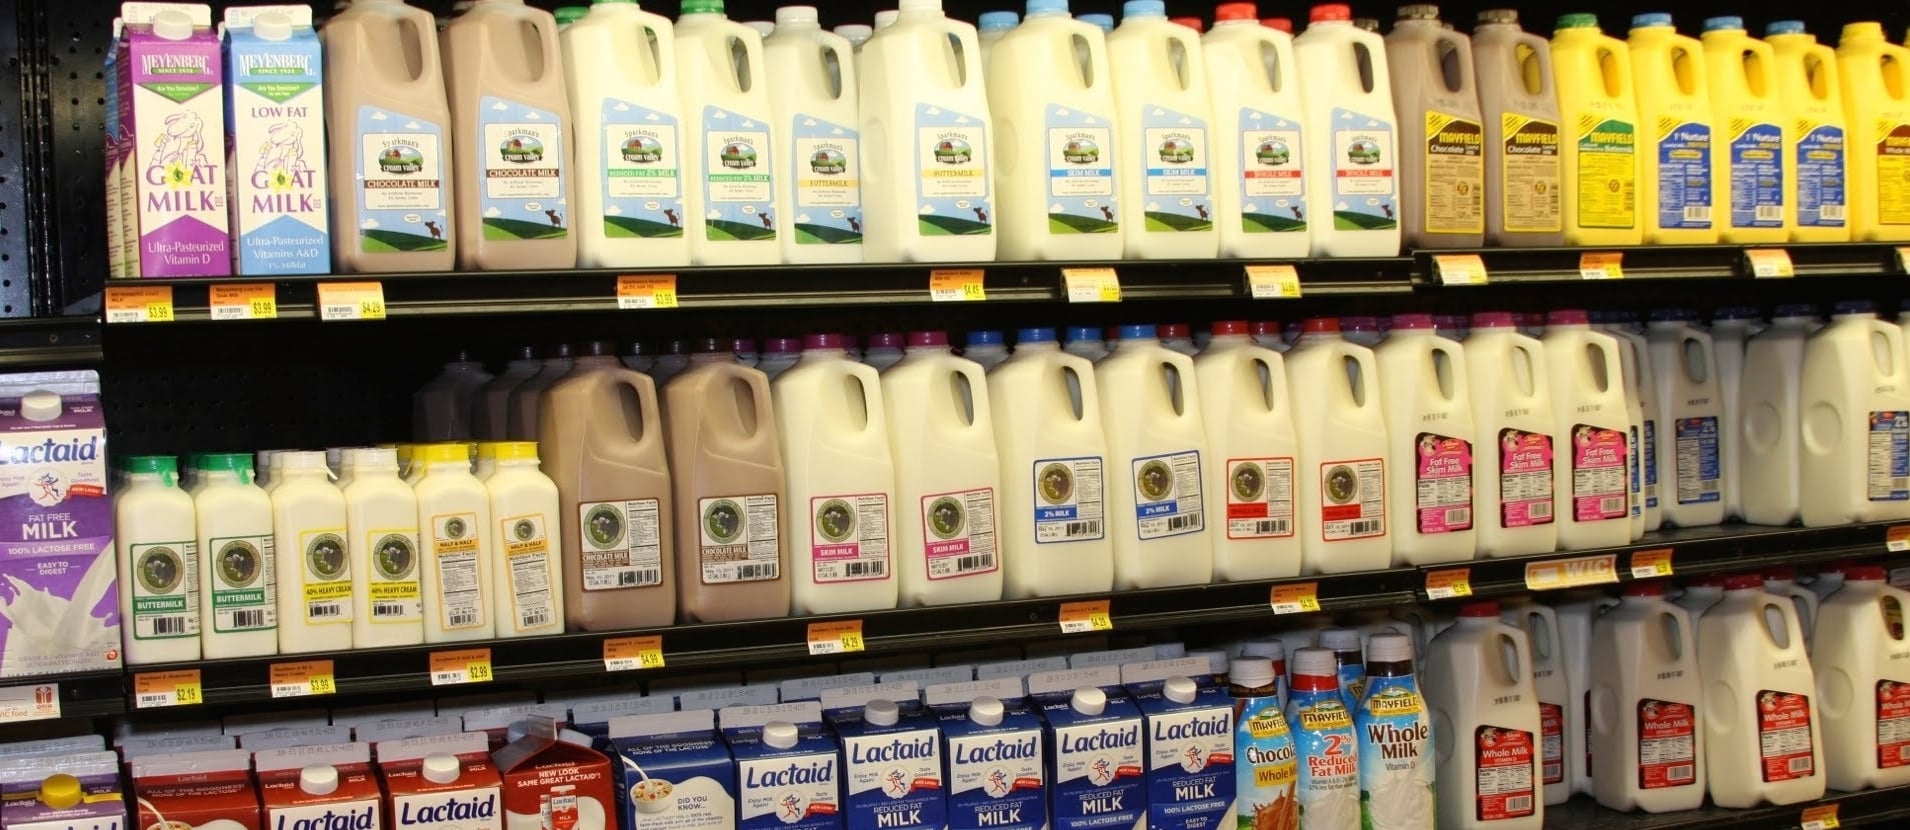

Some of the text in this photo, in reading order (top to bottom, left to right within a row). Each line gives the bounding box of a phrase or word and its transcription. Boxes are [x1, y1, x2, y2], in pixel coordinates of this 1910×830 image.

[142, 53, 213, 75] MEYENBERG
[240, 53, 315, 76] MEYENBERG
[251, 107, 310, 119] LOW FAT
[1439, 132, 1481, 144] MAYFIELD
[1516, 132, 1558, 144] MAYFIELD
[1431, 145, 1465, 153] Chocolate
[1508, 145, 1541, 153] Chocolate
[537, 169, 557, 177] MILK
[934, 169, 974, 178] BUTTERMILK
[1162, 168, 1195, 176] SKIM MILK
[147, 190, 216, 213] MILK
[252, 194, 314, 213] MILK
[148, 241, 224, 254] Ultra-Pasteurized
[247, 237, 324, 251] Ultra-Pasteurized
[253, 247, 318, 261] Vitamins A&D
[164, 254, 212, 267] Vitamin D
[149, 306, 168, 319] $3.99
[252, 302, 272, 316] $3.99
[362, 301, 381, 314] $4.29
[1702, 420, 1716, 433] 2%
[1512, 452, 1542, 461] Fat Free
[1586, 447, 1614, 456] Fat Free
[1429, 457, 1460, 466] Fat Free
[1510, 460, 1545, 470] Skim Milk
[1583, 455, 1618, 465] Skim Milk
[1426, 465, 1463, 475] Skim Milk
[1155, 505, 1170, 513] MILK
[29, 512, 71, 523] FAT FREE
[22, 519, 78, 541] MILK
[8, 543, 95, 556] 100% LACTOSE FREE
[701, 547, 733, 555] CHOCOLATE
[820, 547, 853, 557] SKIM MILK
[932, 543, 964, 554] SKIM MILK
[582, 553, 614, 561] CHOCOLATE
[37, 562, 56, 570] EASY
[39, 568, 67, 576] DIGEST
[1564, 557, 1610, 577] WIC
[137, 599, 184, 609] BUTTERMILK
[216, 593, 263, 603] BUTTERMILK
[1091, 615, 1107, 627] $4.29
[841, 636, 859, 649] $4.29
[640, 652, 658, 664] $4.99
[469, 666, 488, 679] $2.99
[310, 678, 330, 691] $3.99
[176, 687, 196, 701] $2.19
[1880, 702, 1904, 711] Whole
[1763, 710, 1806, 722] Whole Milk
[1155, 713, 1230, 742] Lactaid
[1644, 719, 1689, 730] Whole Milk
[1367, 721, 1429, 744] Whole
[1062, 725, 1138, 754] Lactaid
[1323, 734, 1353, 756] 2%
[852, 735, 935, 765] Lactaid
[955, 736, 1037, 765] Lactaid
[1381, 742, 1418, 760] Milk
[1482, 747, 1529, 759] Whole Milk
[1308, 753, 1358, 767] Reduced
[1385, 761, 1415, 771] Vitamin D
[539, 768, 580, 778] NEW LOOK
[747, 759, 832, 789] Lactaid
[1258, 769, 1289, 782] Whole
[1311, 763, 1357, 777] Fat Milk
[539, 776, 564, 786] GREAT
[1172, 775, 1217, 788] REDUCED FAT
[1079, 791, 1112, 800] REDUCED
[1175, 783, 1216, 802] MILK
[692, 795, 708, 803] YOU
[401, 793, 496, 825] Lactaid
[677, 803, 706, 811] KNOW...
[873, 803, 909, 814] REDUCED
[974, 801, 1022, 813] REDUCED FAT
[1083, 796, 1123, 815] MILK
[1163, 800, 1225, 815] 100% LACTOSE FREE
[277, 806, 374, 829] Lactaid
[877, 809, 922, 828] MILK
[978, 808, 1021, 827] MILK
[1070, 820, 1088, 828] 100%
[1088, 817, 1118, 826] LACTOSE
